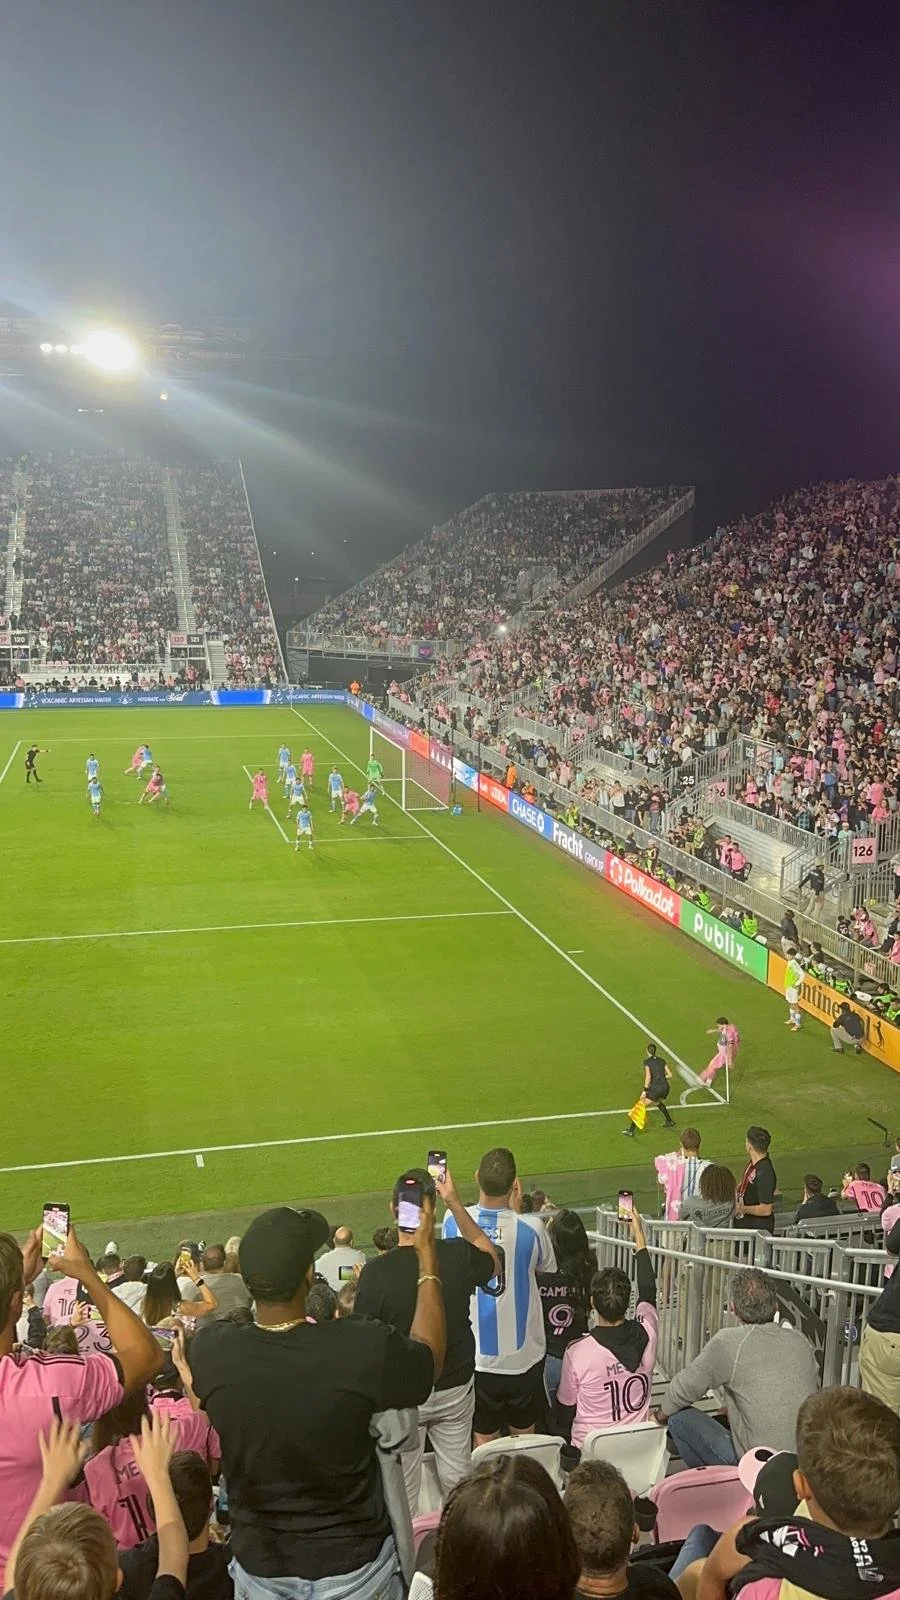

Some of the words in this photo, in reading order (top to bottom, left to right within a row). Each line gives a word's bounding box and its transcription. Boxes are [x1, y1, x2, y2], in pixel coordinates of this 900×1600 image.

[680, 776, 695, 785] 25
[512, 799, 537, 827] CHASE
[553, 821, 583, 859] Fracht
[854, 846, 873, 857] 126
[624, 868, 674, 918] Polkadot
[862, 1190, 883, 1209] 10
[548, 1303, 574, 1335] 9
[603, 1372, 649, 1422] 10
